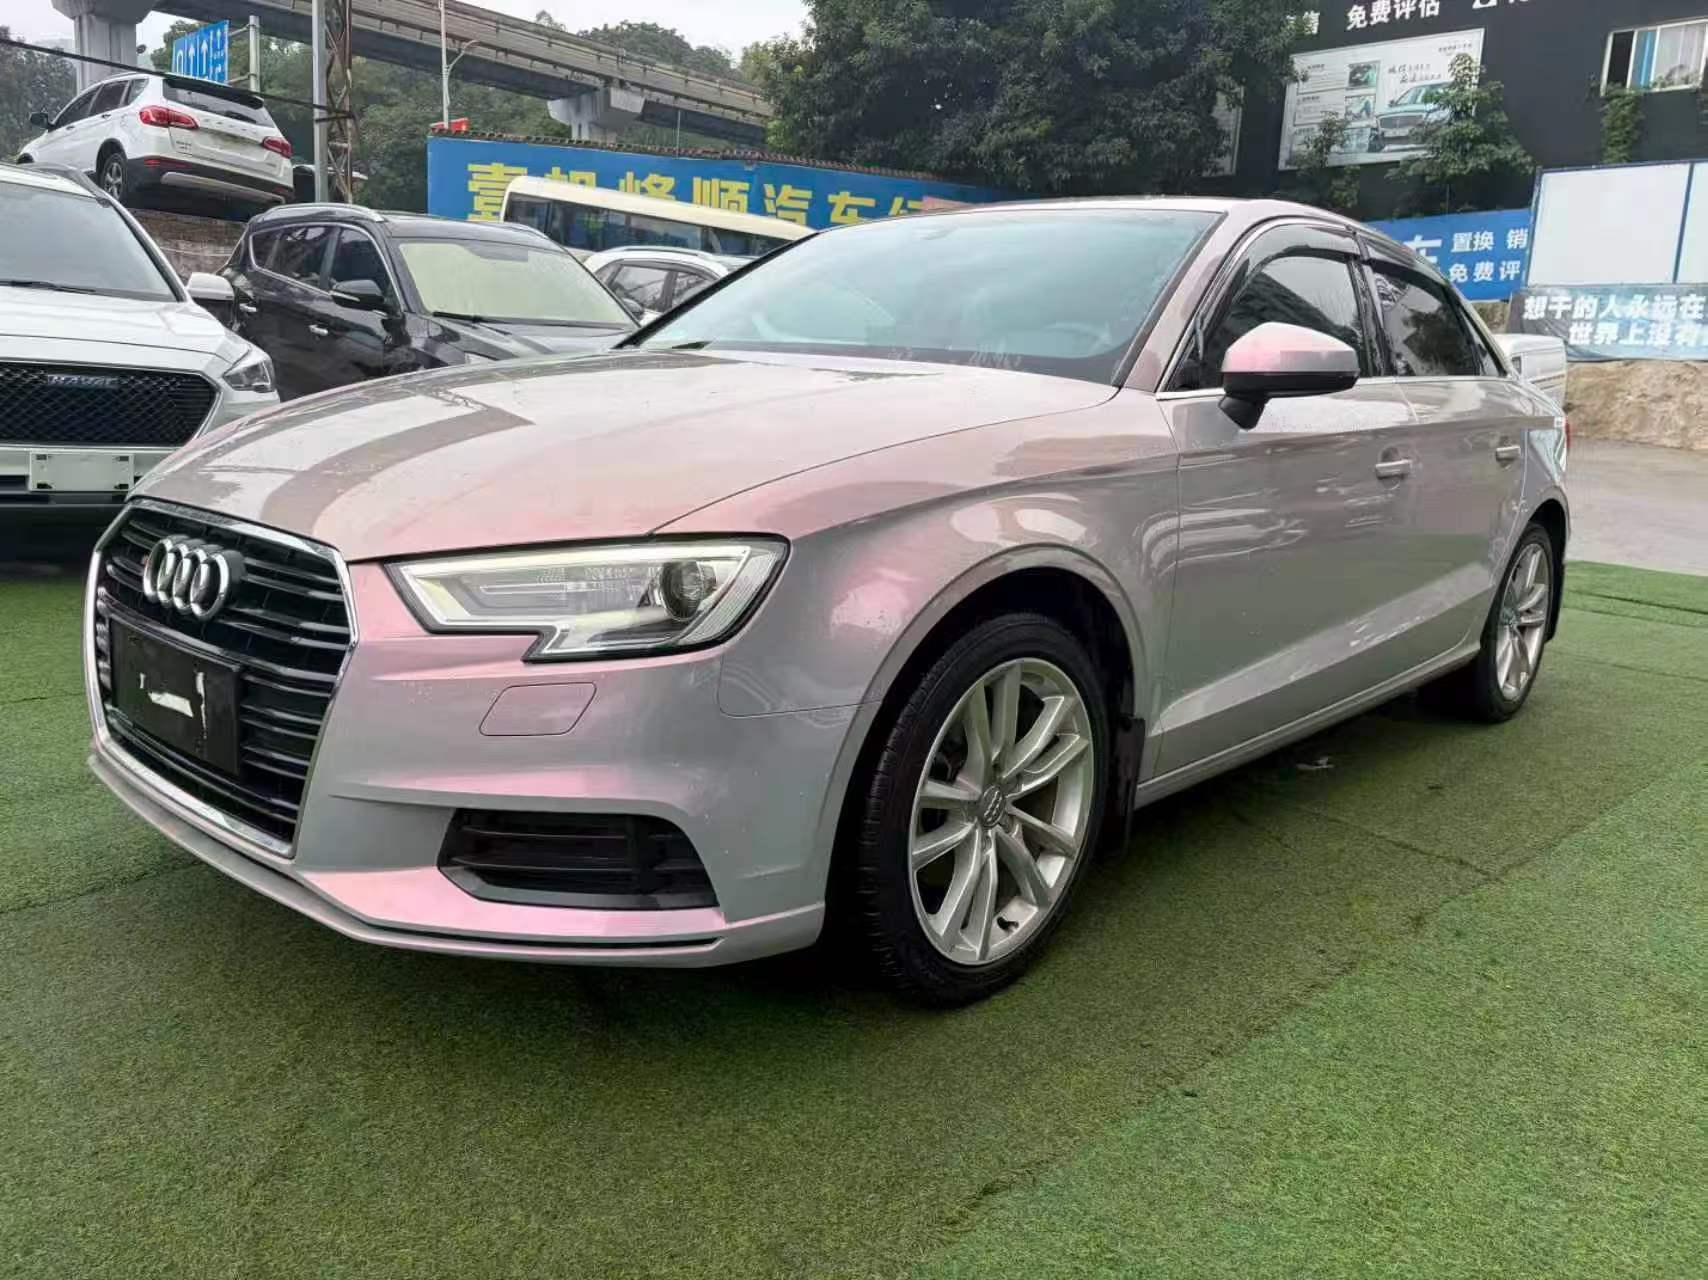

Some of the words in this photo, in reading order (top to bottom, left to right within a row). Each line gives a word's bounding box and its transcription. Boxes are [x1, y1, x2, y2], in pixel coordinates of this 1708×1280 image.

[1346, 0, 1440, 30] 免费评估
[1451, 230, 1494, 252] 置换
